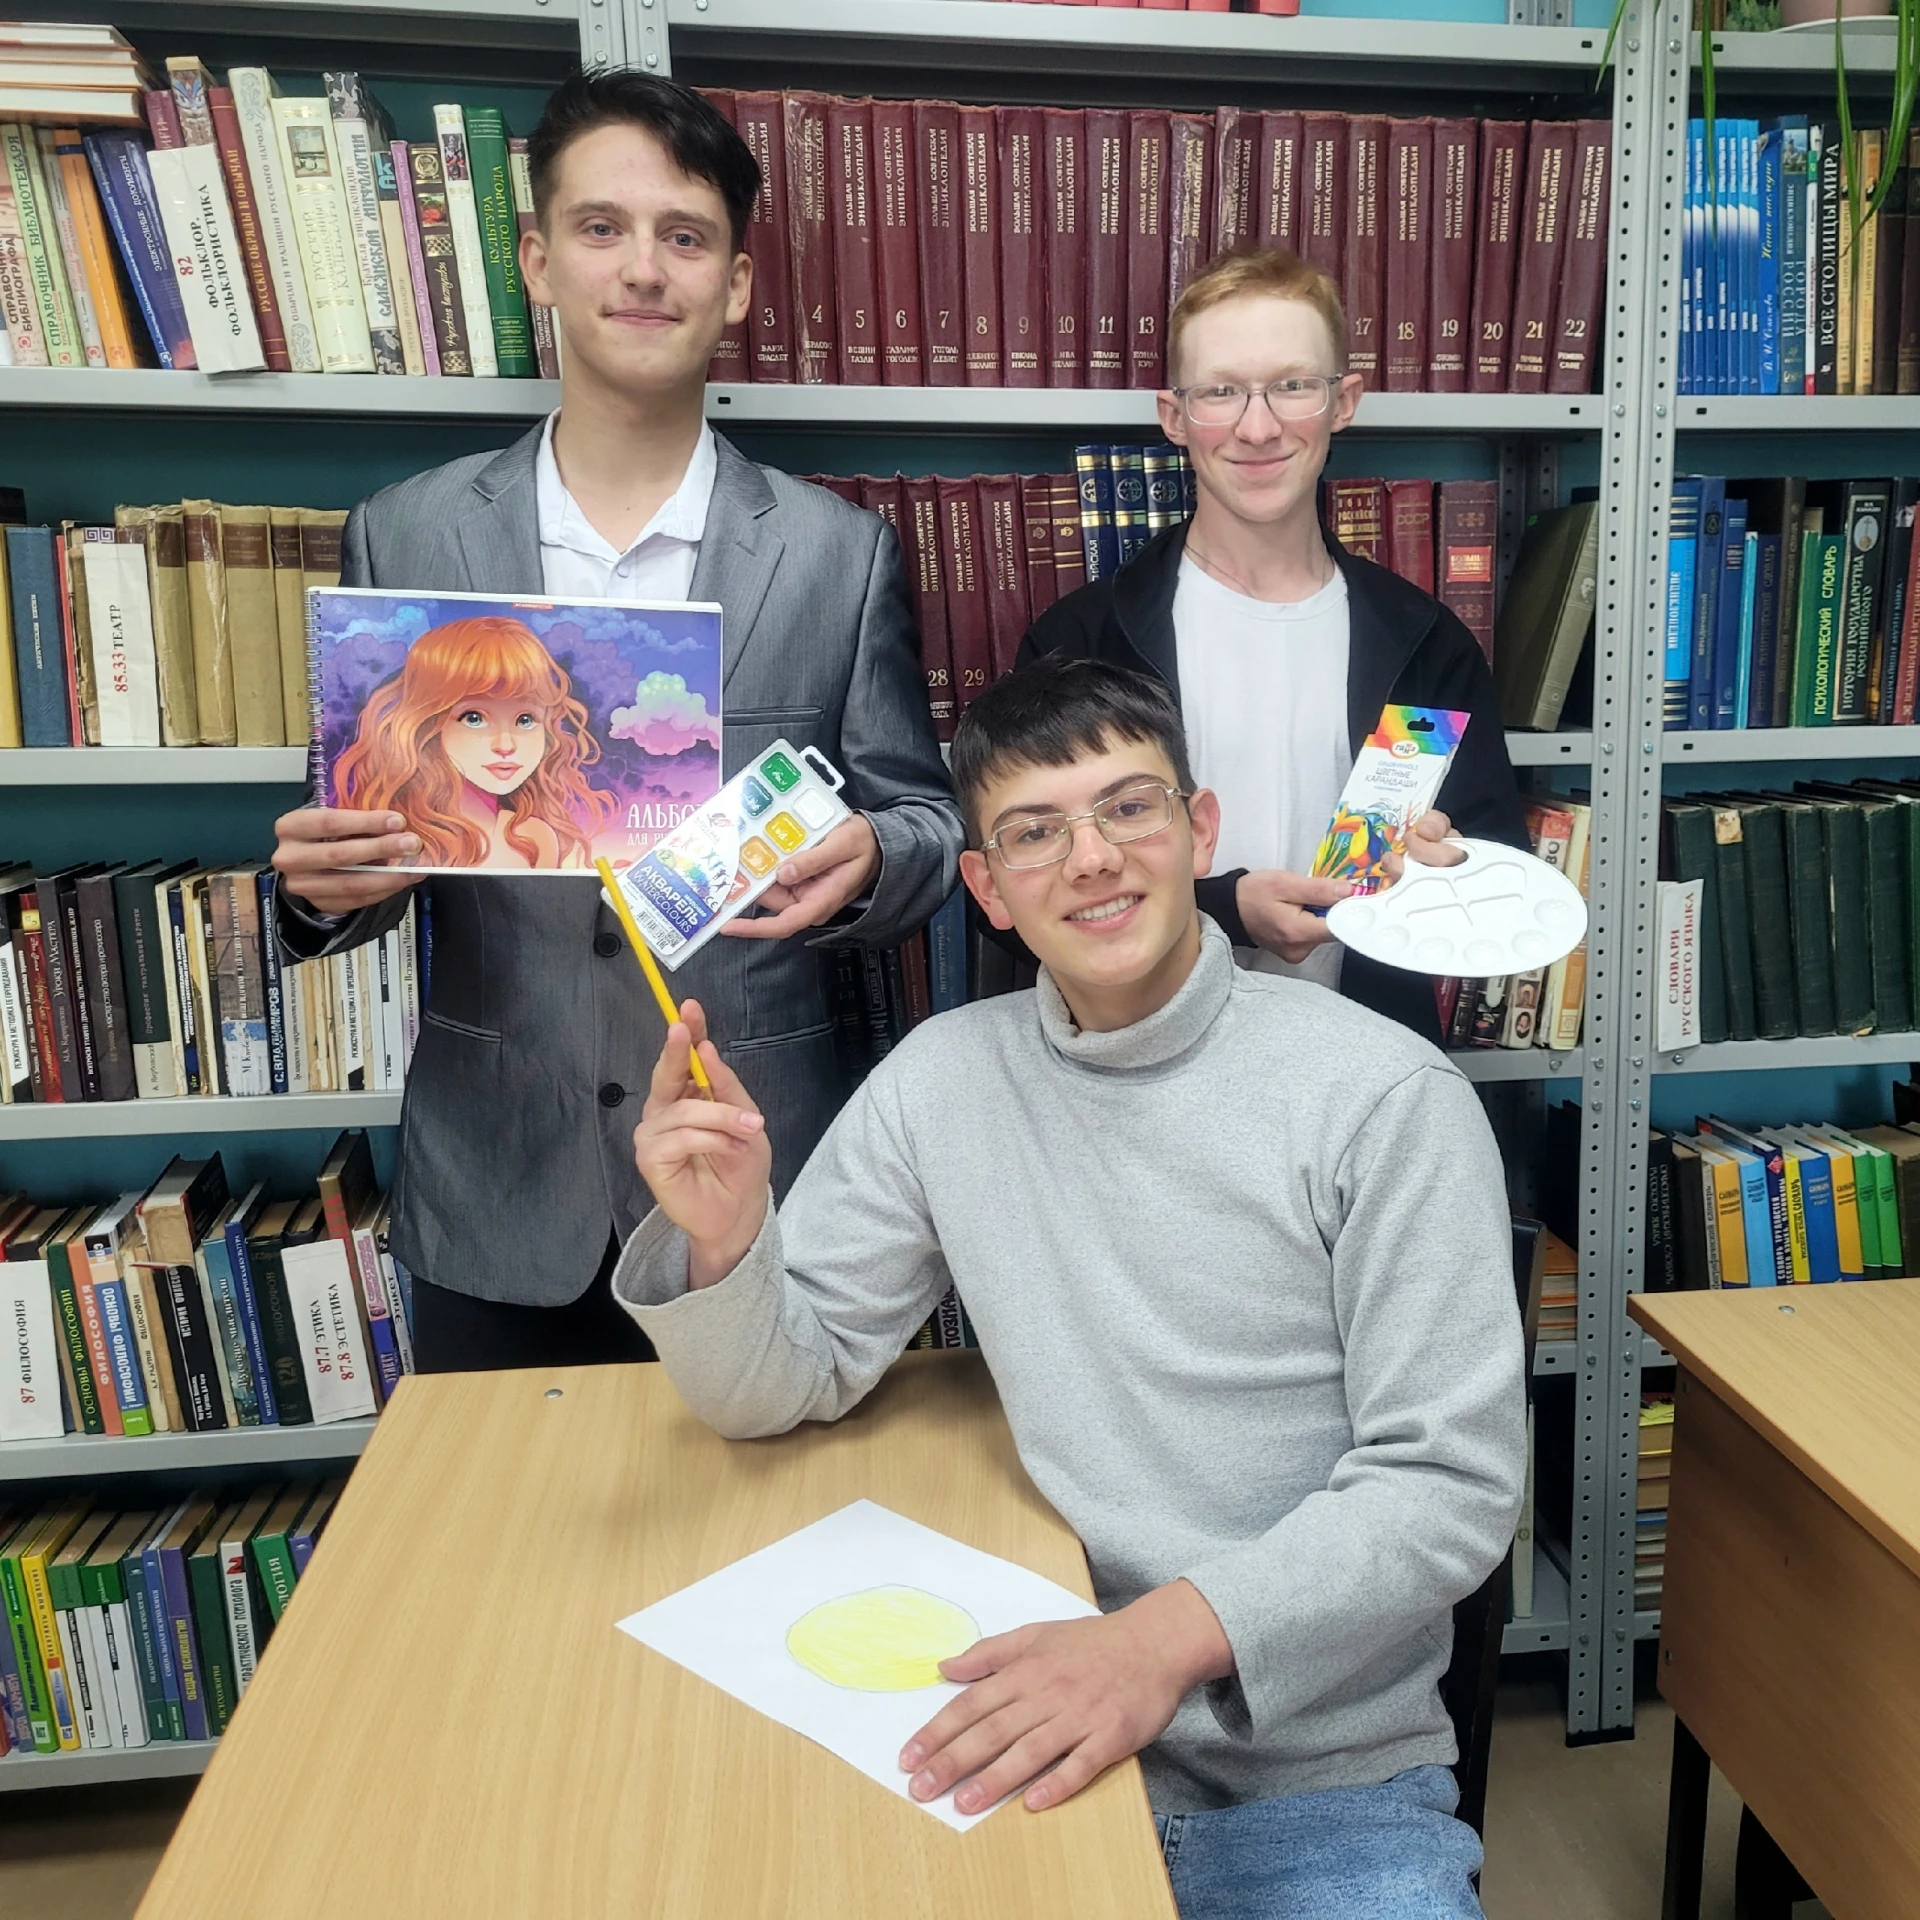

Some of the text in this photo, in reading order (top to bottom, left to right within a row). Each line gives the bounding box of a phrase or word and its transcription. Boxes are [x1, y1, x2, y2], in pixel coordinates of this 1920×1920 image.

[255, 122, 268, 161] НАРОДА
[929, 128, 937, 181] СОВЕТСКАЯ
[966, 133, 975, 184] СОВЕТСКАЯ
[263, 164, 278, 214] РУССКОГО
[842, 126, 854, 226] БОЛЬШАЯ СОВЕТСКАЯ
[854, 126, 866, 226] ЭНЦИКЛОПЕДИЯ
[940, 129, 949, 228] ЭНЦИКЛОПЕДИЯ
[1111, 139, 1120, 234] ЭНЦИКЛОПЕДИЯ
[1400, 146, 1408, 196] СОВЕТСКАЯ
[1409, 146, 1418, 242] ЭНЦИКЛОПЕДИЯ
[1535, 148, 1551, 242] БОЛЬШАЯ СОВЕТСКАЯ
[1545, 149, 1562, 242] ЭНЦИКЛОПЕДИЯ
[119, 155, 162, 271] ЭЛЕКТРОННЫЕ ДОКУМЕНТЫ
[227, 149, 271, 313] РУССКИЕ ОБРЯДЫ И ОБЫЧАИ
[483, 195, 501, 264] КУЛЬТУРА
[492, 165, 516, 293] РУССКОГО НАРОДА
[8, 134, 61, 346] СПРАВОЧНИК БИБЛИОТЕКАРЯ
[177, 255, 195, 275] 82
[190, 217, 219, 308] ФОЛЬКЛОР.
[198, 184, 242, 336] ФОЛЬКЛОРИСТИКА
[1821, 143, 1839, 345] ВСЕ СТОЛИЦЫ МИРА
[7, 238, 33, 331] БИБЛИОГРАФА
[283, 270, 291, 278] И
[1782, 261, 1794, 338] РОССИИ
[285, 281, 300, 322] ОБЫЧАИ
[764, 307, 775, 326] 3
[812, 304, 822, 323] 4
[855, 309, 865, 328] 5
[895, 309, 907, 328] 6
[939, 311, 949, 329] 7
[976, 316, 987, 335] 8
[1019, 317, 1029, 334] 9
[1058, 316, 1074, 333] 10
[1099, 316, 1114, 334] 11
[1138, 316, 1154, 334] 13
[1356, 318, 1372, 335] 17
[1398, 322, 1415, 340] 18
[1441, 319, 1459, 338] 19
[1483, 322, 1504, 340] 20
[1525, 321, 1544, 339] 21
[1564, 319, 1586, 338] 22
[915, 502, 925, 549] СОВЕТСКАЯ
[1396, 513, 1429, 525] СССР
[925, 501, 939, 591] ЭНЦИКЛОПЕДИЯ
[951, 502, 964, 591] БОЛЬШАЯ СОВЕТСКАЯ
[961, 502, 974, 591] ЭНЦИКЛОПЕДИЯ
[109, 604, 128, 692] 85.33 ТЕАТР
[1814, 545, 1837, 714] ПСИХОЛОГИЧЕСКИЙ СЛОВАРЬ
[1842, 555, 1864, 709] ИСТОРИЯ ГОСУДАРСТВА
[1856, 586, 1873, 678] РОССИЙСКОГО
[928, 669, 948, 687] 28
[964, 669, 984, 687] 29
[1366, 775, 1418, 788] КАРАНДАШИ
[1376, 768, 1412, 778] ЦВЕТНЫЕ
[626, 804, 703, 829] АЛЬБО
[626, 833, 648, 846] ДЛЯ
[658, 850, 672, 861] 12
[632, 870, 692, 934] WATERCOLOURS
[638, 864, 698, 928] АКВАРЕЛЬ
[1669, 930, 1680, 1005] СЛОВАРИ
[1682, 893, 1694, 1037] РУССКОГО ЯЗЫКА
[268, 987, 284, 1082] С. ВЛАДИМИРОВ
[347, 997, 356, 1024] МЕТОДИКА
[351, 1029, 359, 1058] РЕЖИССУРА
[1791, 1179, 1800, 1210] СЛОВАРЬ
[93, 1243, 107, 1263] СПО
[1652, 1216, 1660, 1246] ЯЗЫКА
[1706, 1186, 1720, 1288] фографический словарь
[1772, 1197, 1786, 1279] СЛОВАРЬ ТРУДНОСТЕЙ
[133, 1294, 148, 1339] ФИЛОСОФИЯ
[177, 1306, 192, 1337] ИСТОРИЯ
[387, 1276, 403, 1323] Этикет
[14, 1300, 35, 1403] 87 ФИЛОСОФИЯ
[61, 1288, 95, 1414] ОСНОВЫ ФИЛОСОФИИ
[82, 1284, 109, 1385] ФИЛОСОФИЯ
[102, 1288, 136, 1402] ОСНОВЫ ФИЛОСОФИИ
[218, 1278, 248, 1387] Русские мыслители
[309, 1299, 332, 1373] 87.7 ЭТИКА
[327, 1284, 355, 1380] 87.8 ЭСТЕТИКА
[381, 1353, 397, 1383] ЭТИКЕТ
[260, 1376, 272, 1416] МЕНЕДЖМЕНТ
[17, 1624, 29, 1659] общения
[136, 1591, 156, 1682] ПЕДАГОГИЧЕСКАЯ ПСИХОЛОГИЯ
[152, 1589, 172, 1677] СОЦИАЛЬНАЯ ПСИХОЛОГИЯ
[230, 1580, 253, 1682] практического психолога
[176, 1619, 197, 1699] ОБЩАЯ ПСИХОЛОГИЯ
[7, 1673, 23, 1712] КАРНЕГИ
[213, 1666, 226, 1718] ПСИХОЛОГИЯ
